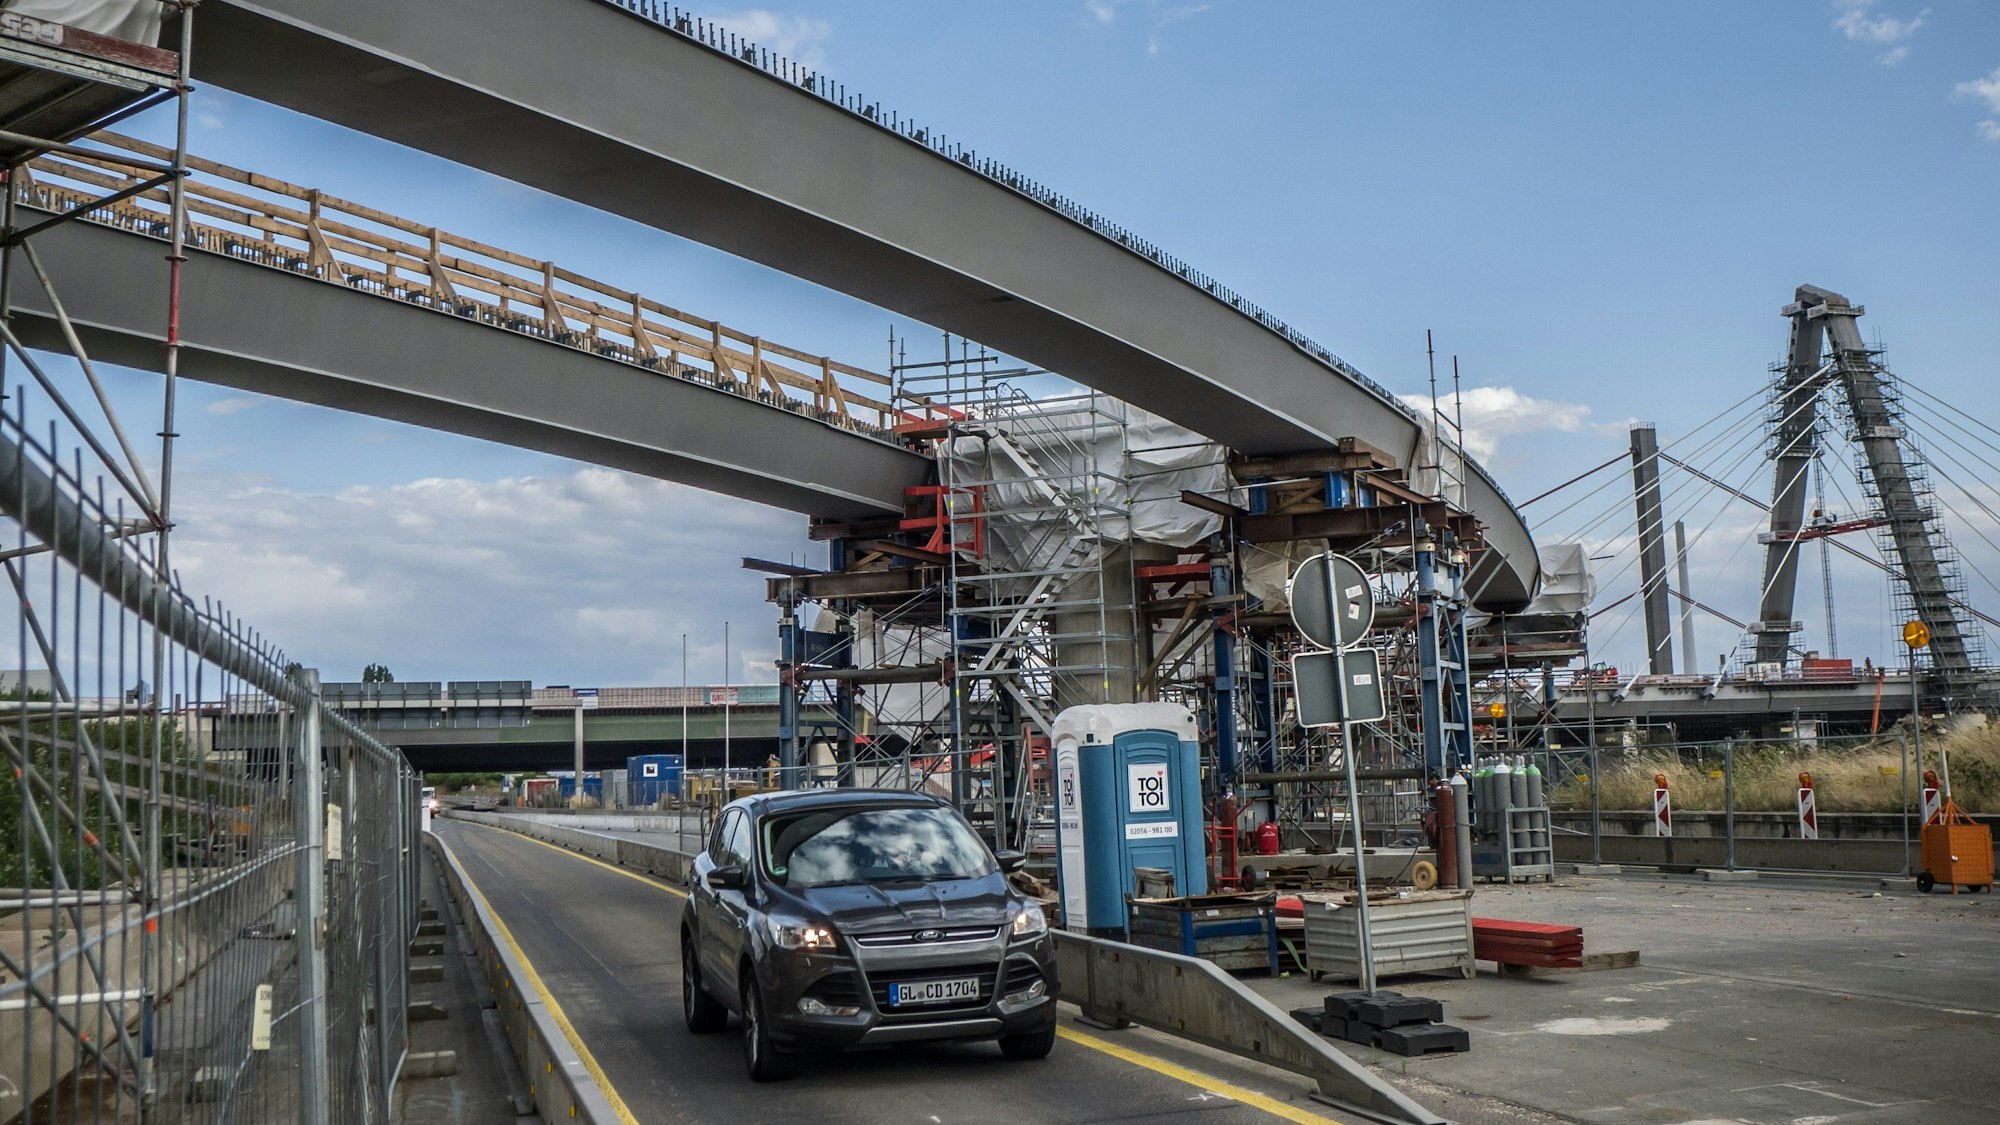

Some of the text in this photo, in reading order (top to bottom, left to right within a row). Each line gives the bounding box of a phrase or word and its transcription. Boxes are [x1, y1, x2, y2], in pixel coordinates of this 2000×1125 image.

[1138, 777, 1163, 791] TOI
[1138, 792, 1164, 805] TOI
[1130, 827, 1147, 835] 02056
[1152, 826, 1163, 834] 981
[921, 930, 939, 940] Ford
[900, 981, 976, 1000] GL CD 1704
